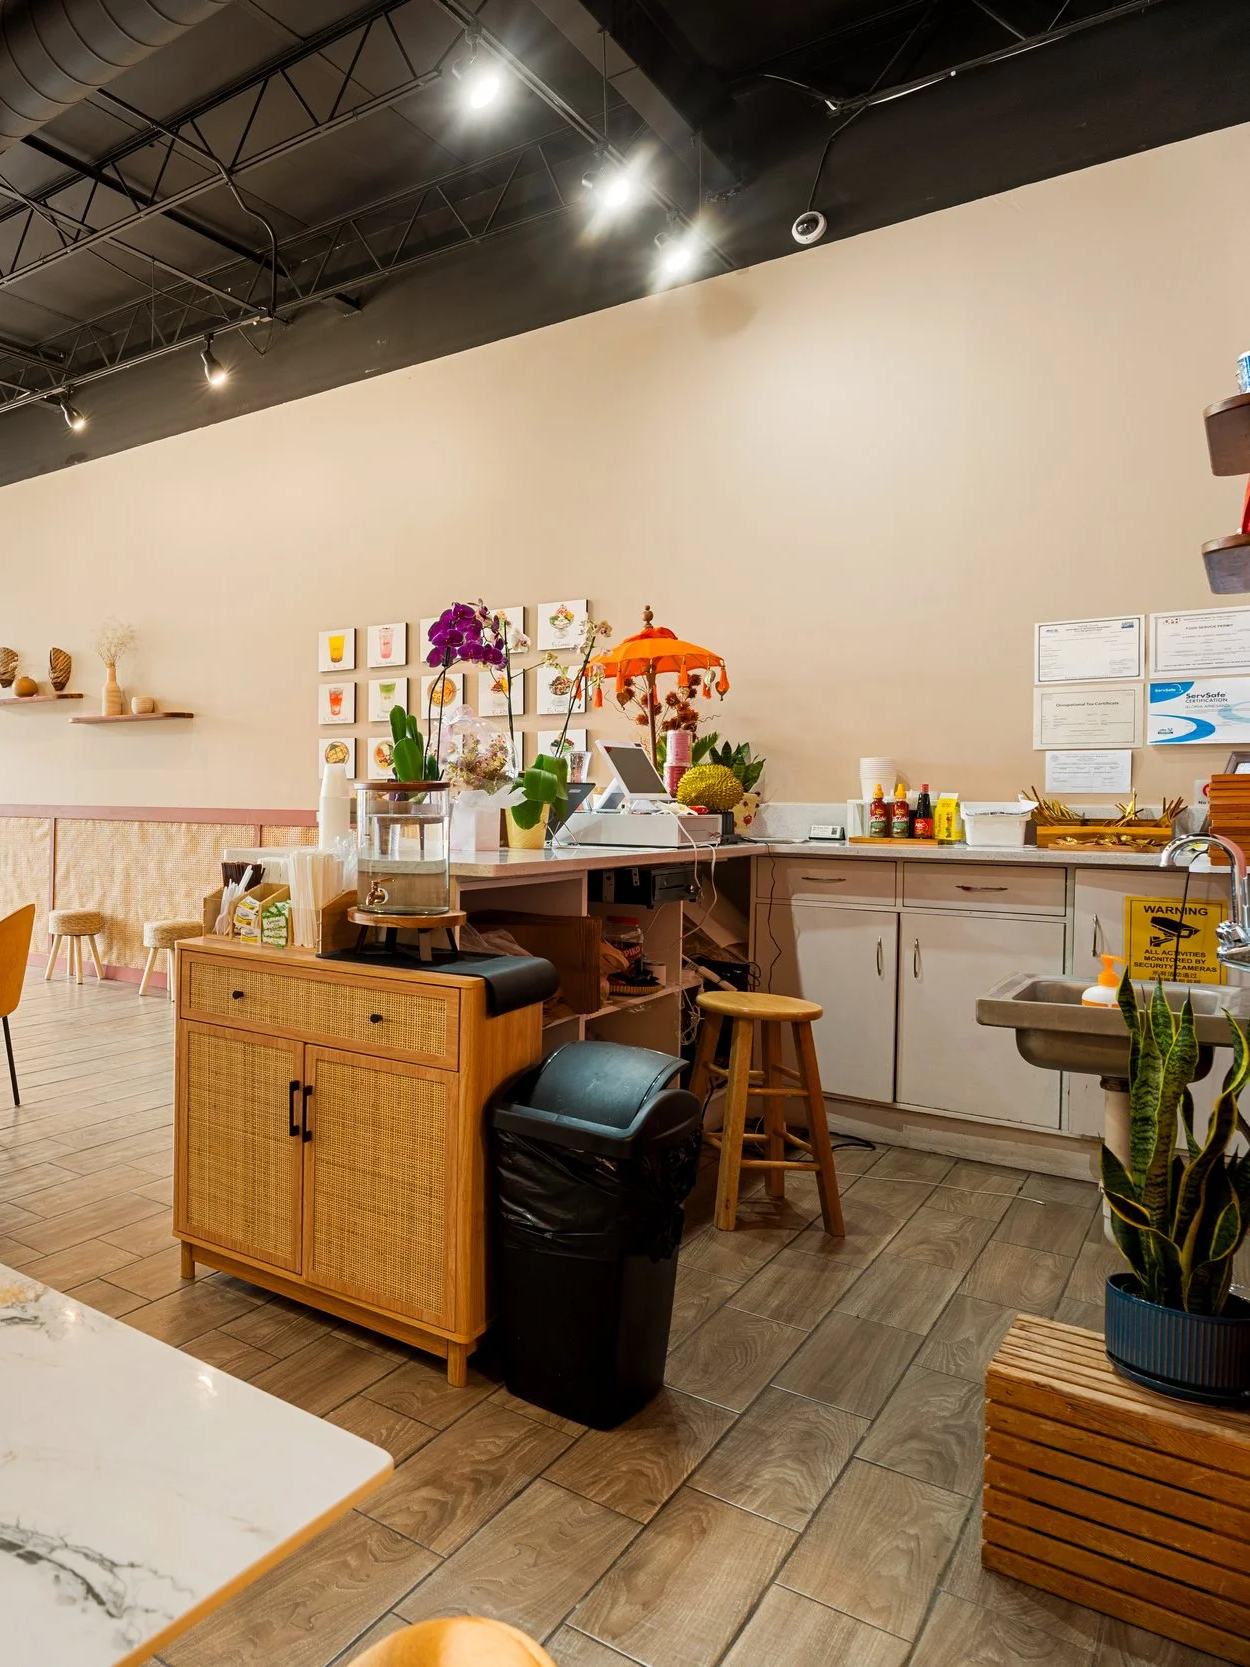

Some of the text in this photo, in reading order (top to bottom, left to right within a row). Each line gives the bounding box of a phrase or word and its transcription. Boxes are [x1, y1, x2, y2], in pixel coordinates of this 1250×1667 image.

[1185, 691, 1226, 699] ServSafe
[1143, 905, 1208, 916] WARNING
[1143, 956, 1193, 964] MONITORED
[1134, 961, 1218, 973] SECURITY CAMERAS
